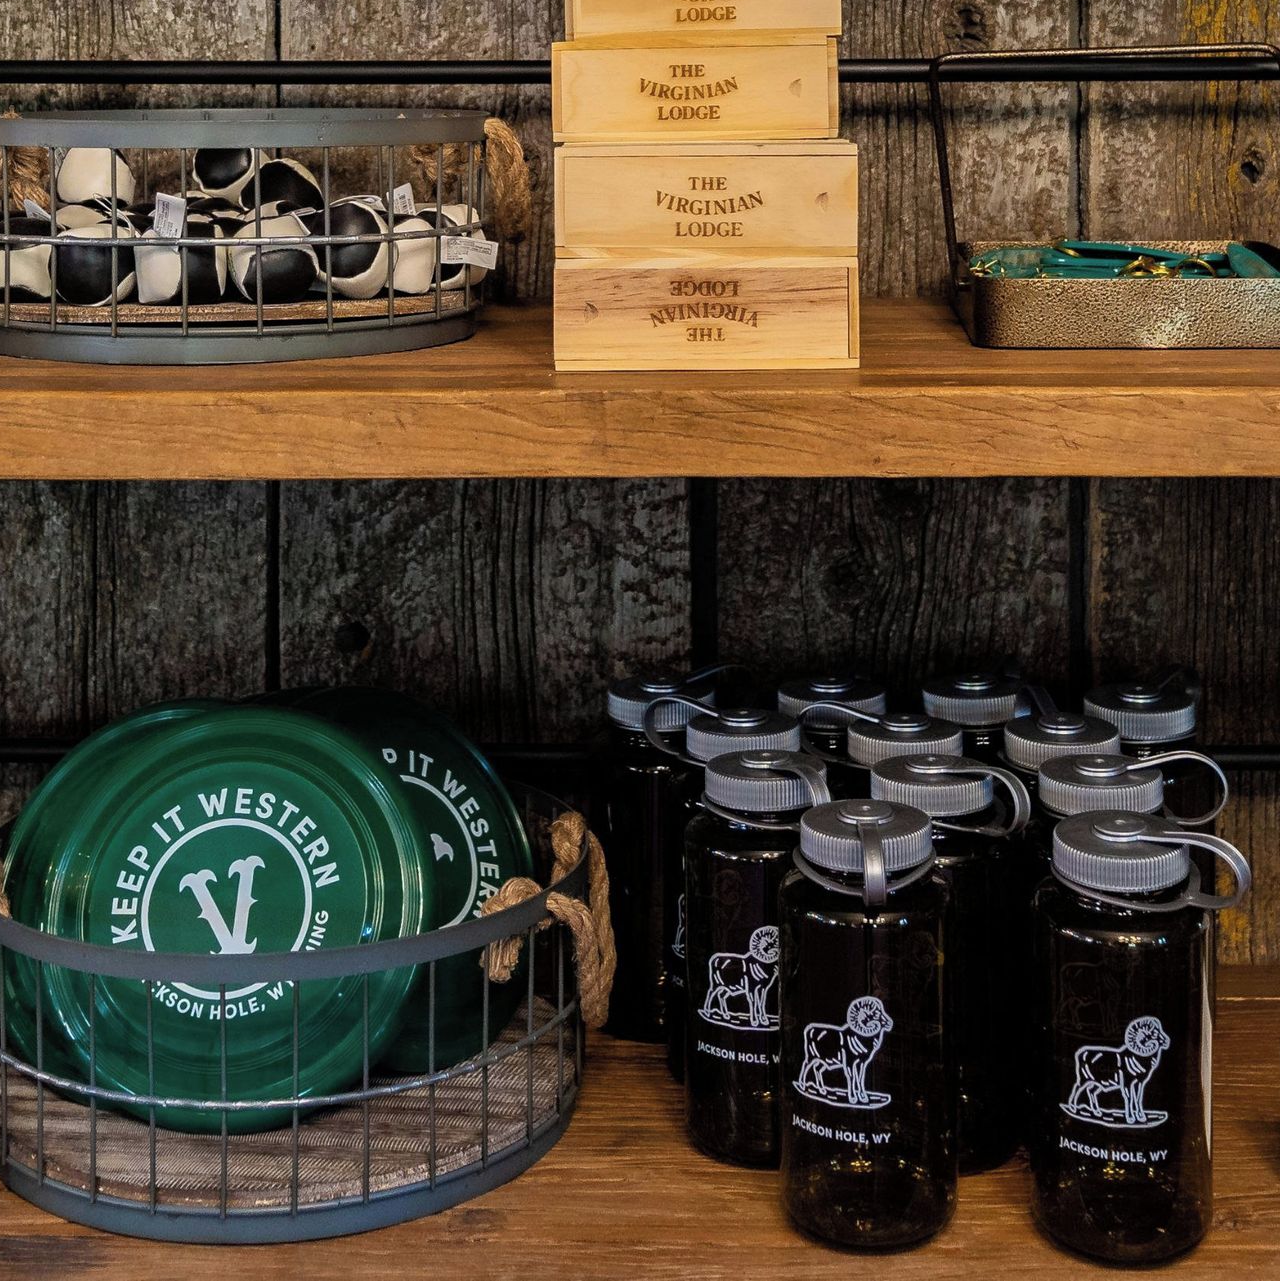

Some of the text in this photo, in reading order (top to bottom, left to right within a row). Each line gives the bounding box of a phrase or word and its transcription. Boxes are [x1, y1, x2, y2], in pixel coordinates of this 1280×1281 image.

[688, 176, 728, 191] THE
[655, 190, 765, 215] VIRGINIAN
[675, 222, 744, 238] LODGE
[670, 280, 739, 297] LODGE
[650, 302, 759, 328] VIRGINIAN
[687, 327, 725, 342] THE
[111, 788, 339, 944] KEEP IT WESTERN
[1059, 1136, 1168, 1163] JACKSON HOLE, WY
